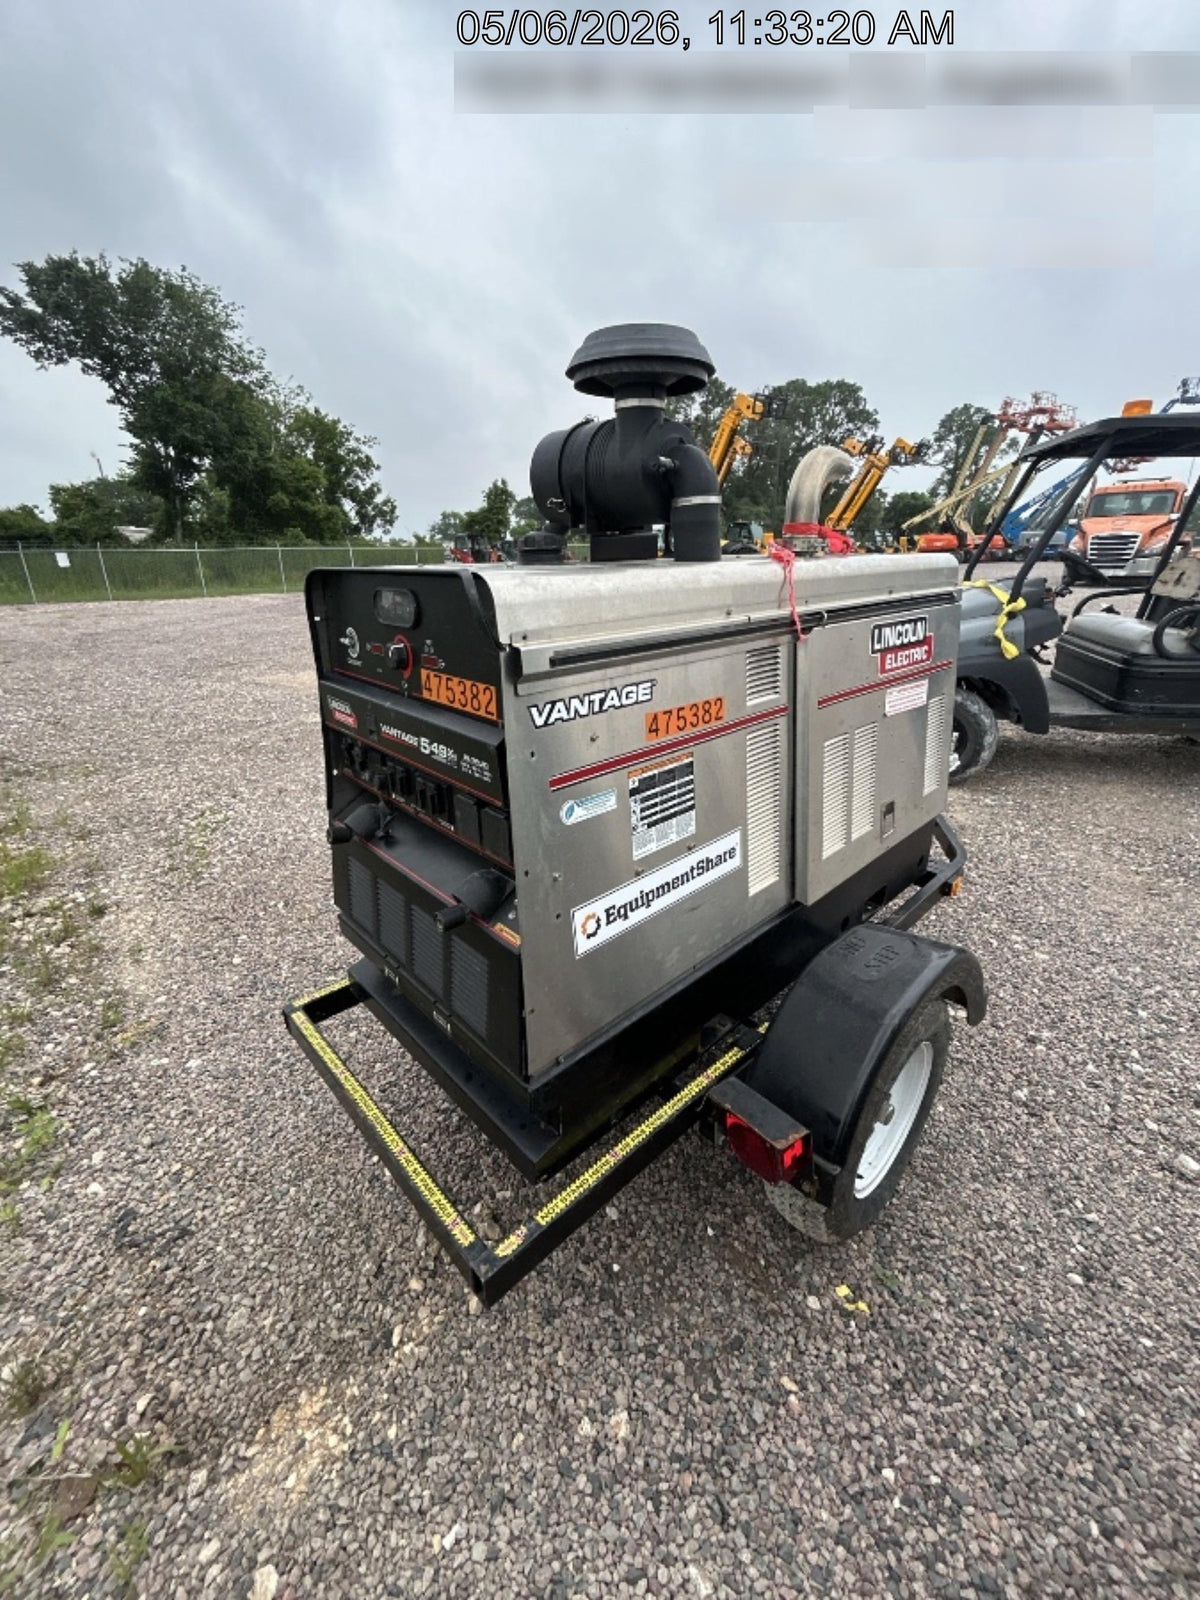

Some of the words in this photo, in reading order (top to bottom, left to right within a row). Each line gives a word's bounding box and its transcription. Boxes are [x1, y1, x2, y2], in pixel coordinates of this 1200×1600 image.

[873, 620, 926, 650] LINCOLN
[885, 645, 929, 671] ELECTRIC
[424, 671, 495, 716] 475382
[528, 681, 655, 729] VANTAGE
[648, 697, 724, 738] 475382
[604, 846, 737, 927] EquipmentShare
